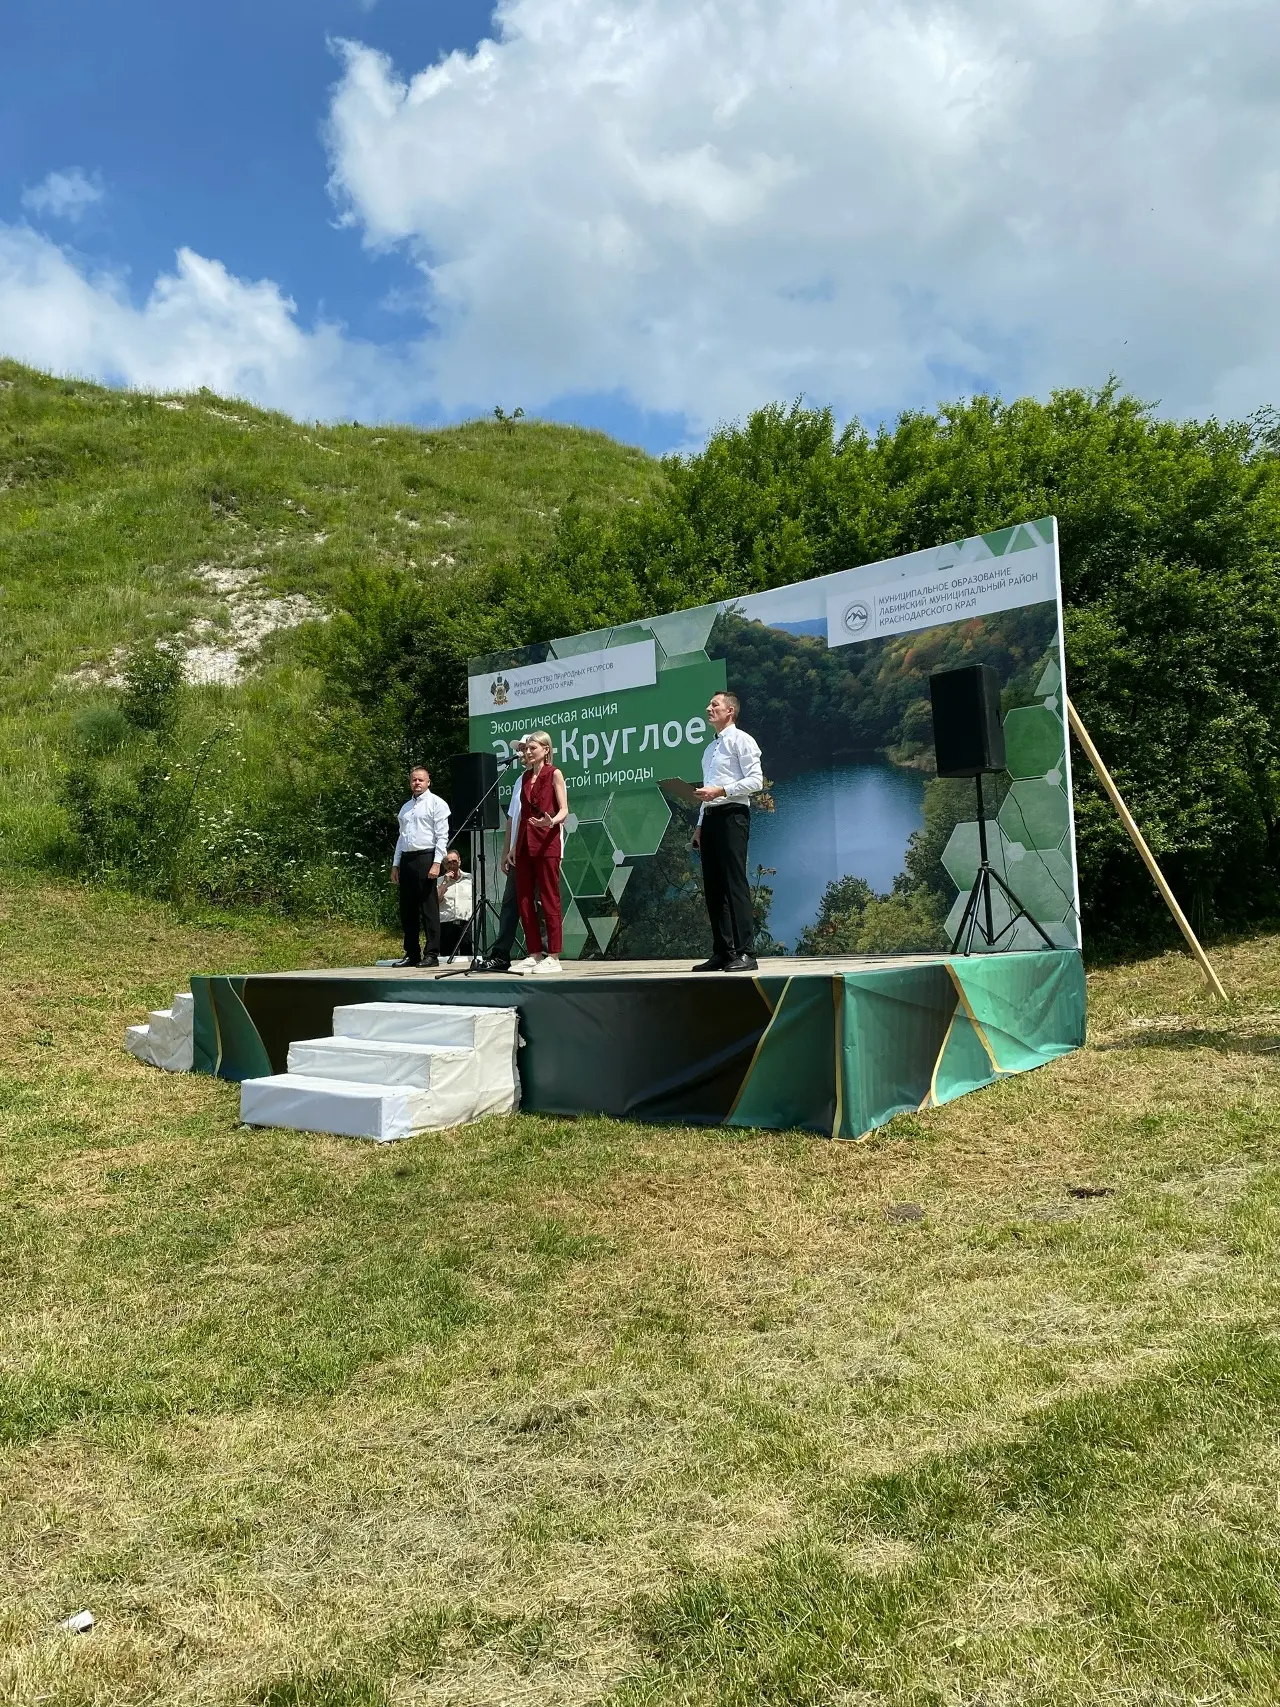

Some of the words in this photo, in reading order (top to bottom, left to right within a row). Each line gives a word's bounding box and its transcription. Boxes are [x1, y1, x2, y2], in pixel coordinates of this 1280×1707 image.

[878, 582, 949, 606] МУНИЦИПАЛЬНОЕ
[951, 566, 1012, 589] ОБРАЗОВАНИЕ
[879, 597, 927, 617] ЛАБИНСКИЙ
[929, 578, 1006, 604] МУНИЦИПАЛЬНЫЙ
[1008, 572, 1038, 587] РАЙОН
[879, 603, 953, 627] КРАСНОДАРСКОГО
[955, 598, 977, 610] КРАЯ
[586, 662, 614, 674] РЕСУРСОВ
[490, 709, 577, 735] Экологическая
[581, 702, 618, 721] акция
[595, 766, 653, 788] природы
